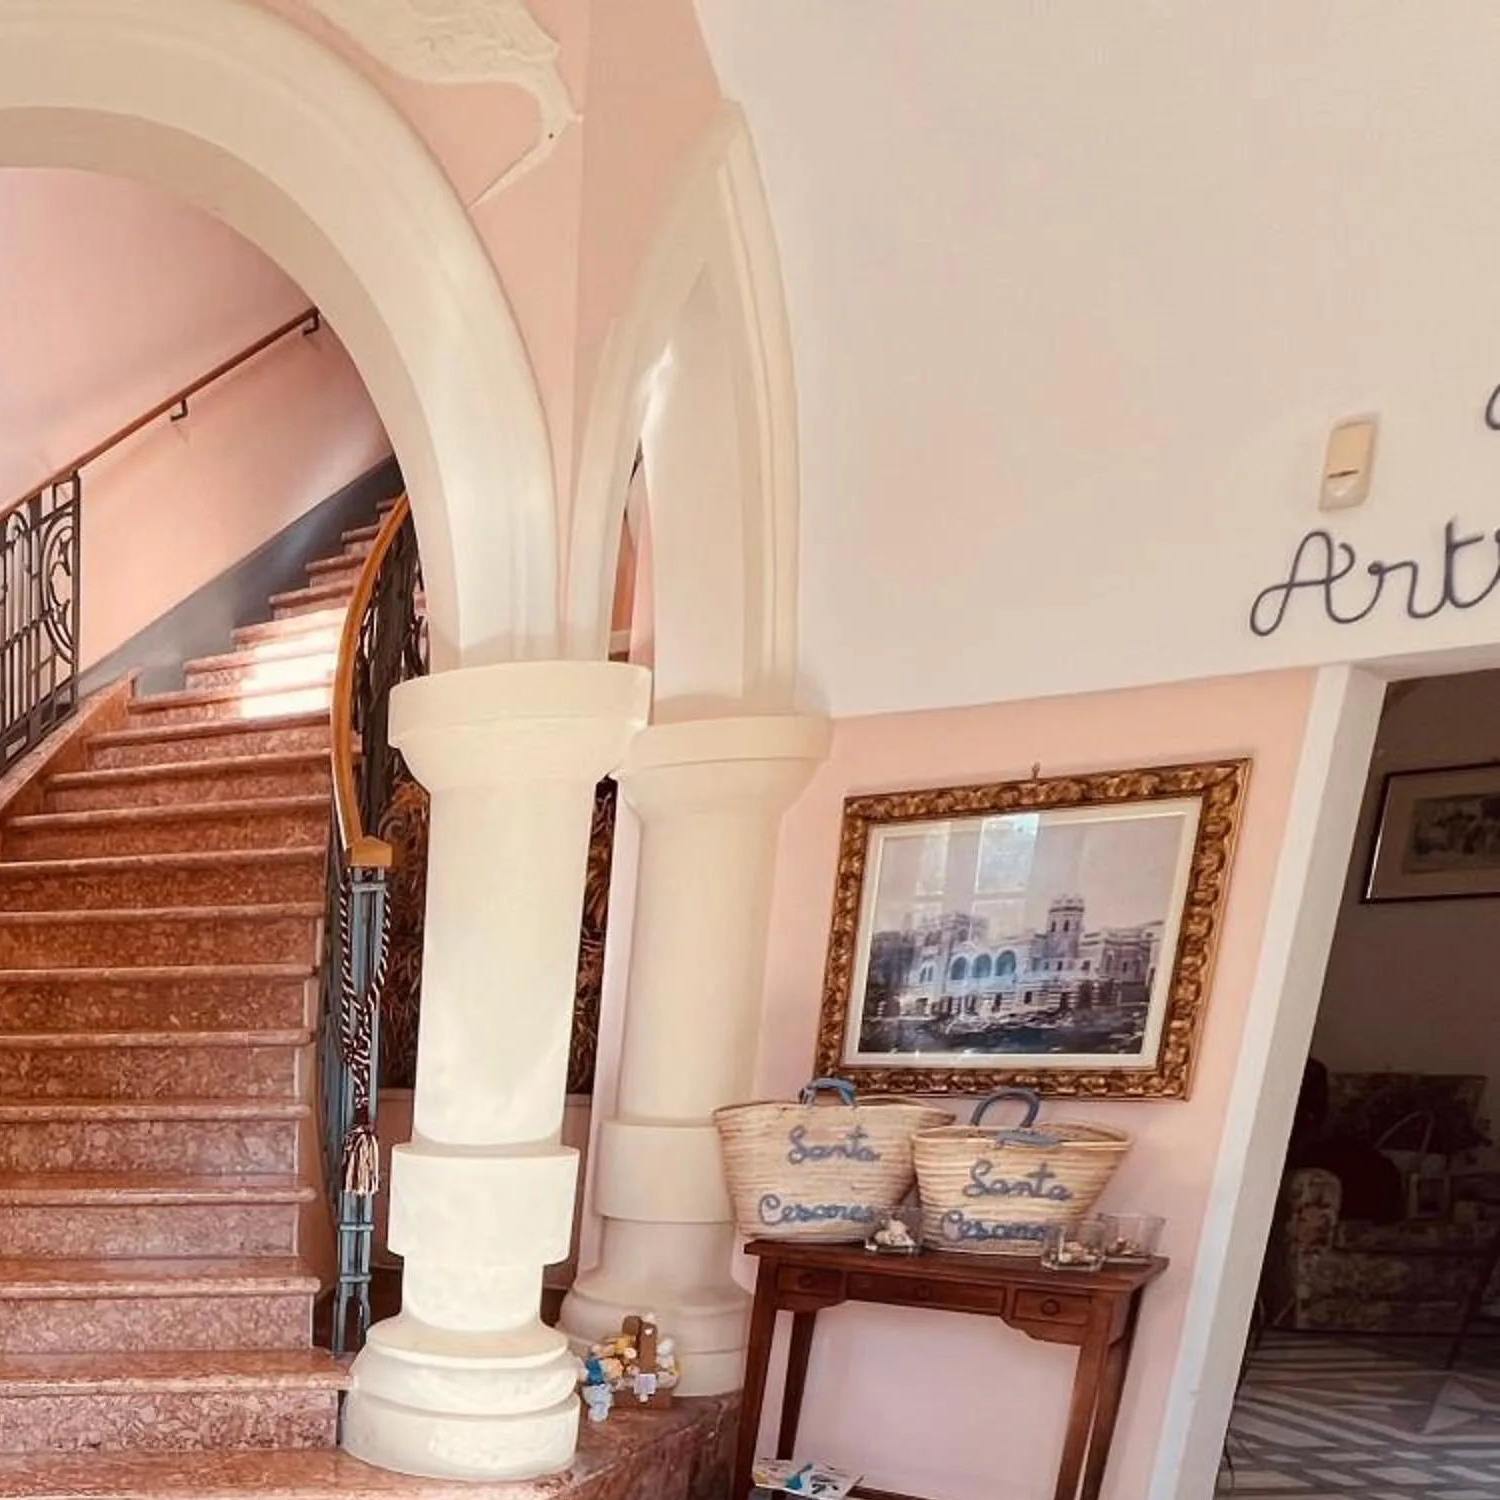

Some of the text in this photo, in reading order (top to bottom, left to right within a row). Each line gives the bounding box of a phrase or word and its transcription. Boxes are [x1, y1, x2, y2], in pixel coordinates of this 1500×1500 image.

[1249, 519, 1500, 637] Art
[788, 1125, 881, 1165] Santa
[962, 1160, 1073, 1201] Santa
